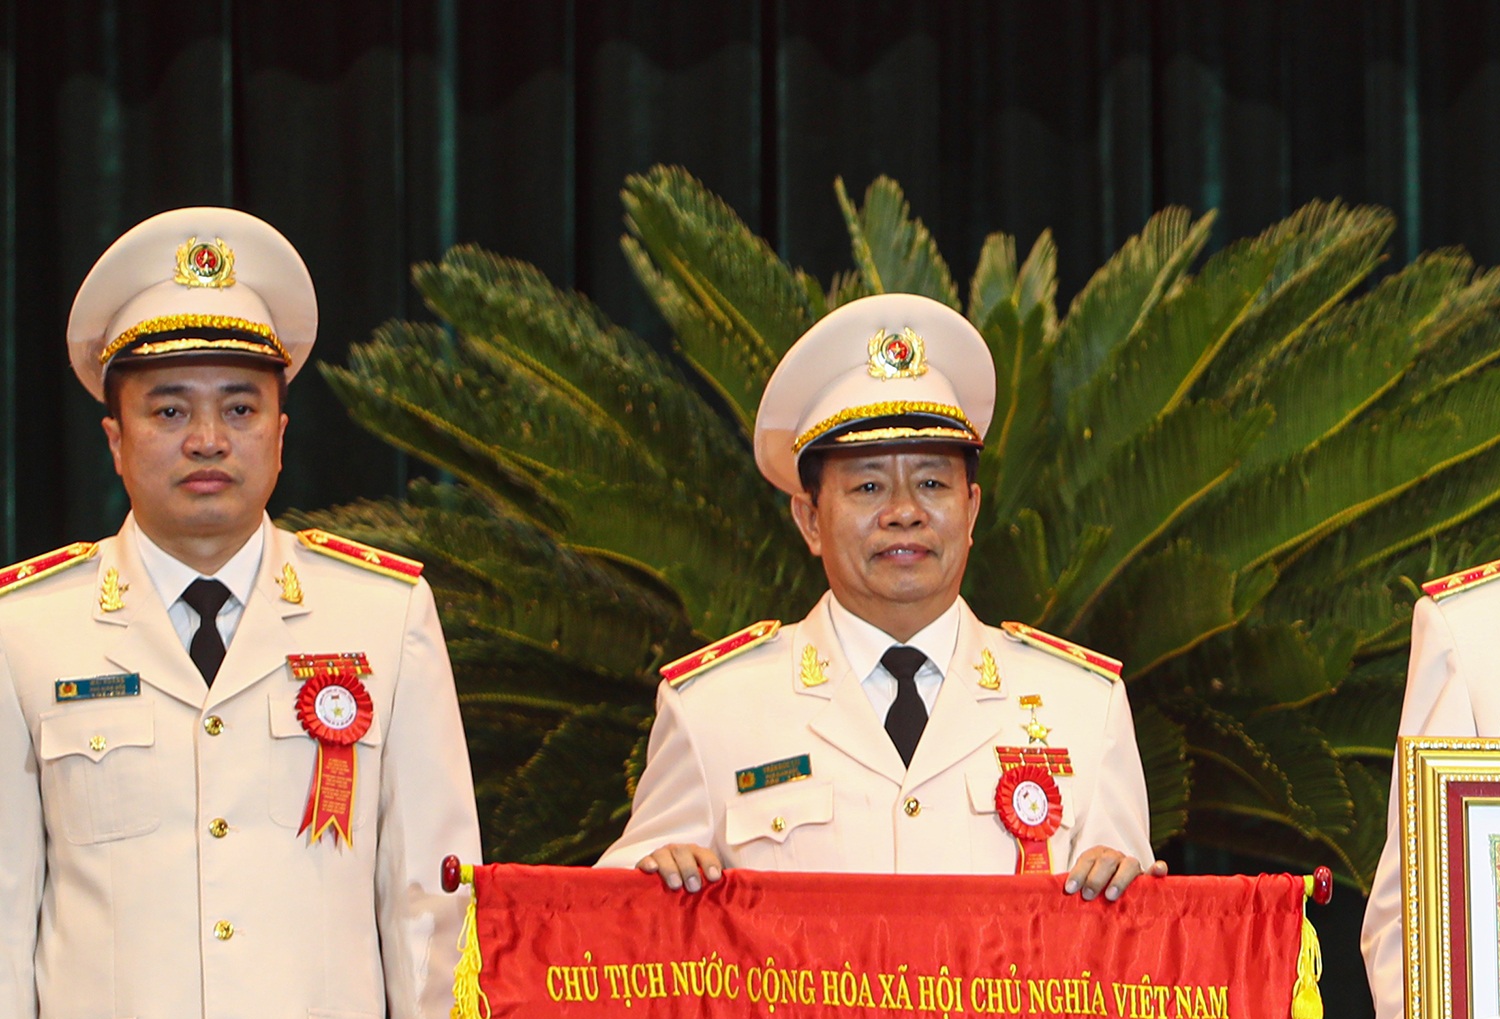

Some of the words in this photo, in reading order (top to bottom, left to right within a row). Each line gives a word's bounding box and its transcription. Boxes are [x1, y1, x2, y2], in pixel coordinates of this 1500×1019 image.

[546, 951, 599, 1002] CHỦ
[603, 962, 668, 1008] TỊCH
[669, 957, 740, 1000] NƯỚC
[746, 957, 816, 1014] CỘNG
[820, 961, 877, 1009] HÒA
[877, 964, 914, 1011] XÃ
[970, 964, 1022, 1015] CHỦ
[1027, 970, 1108, 1017] NGHĨA
